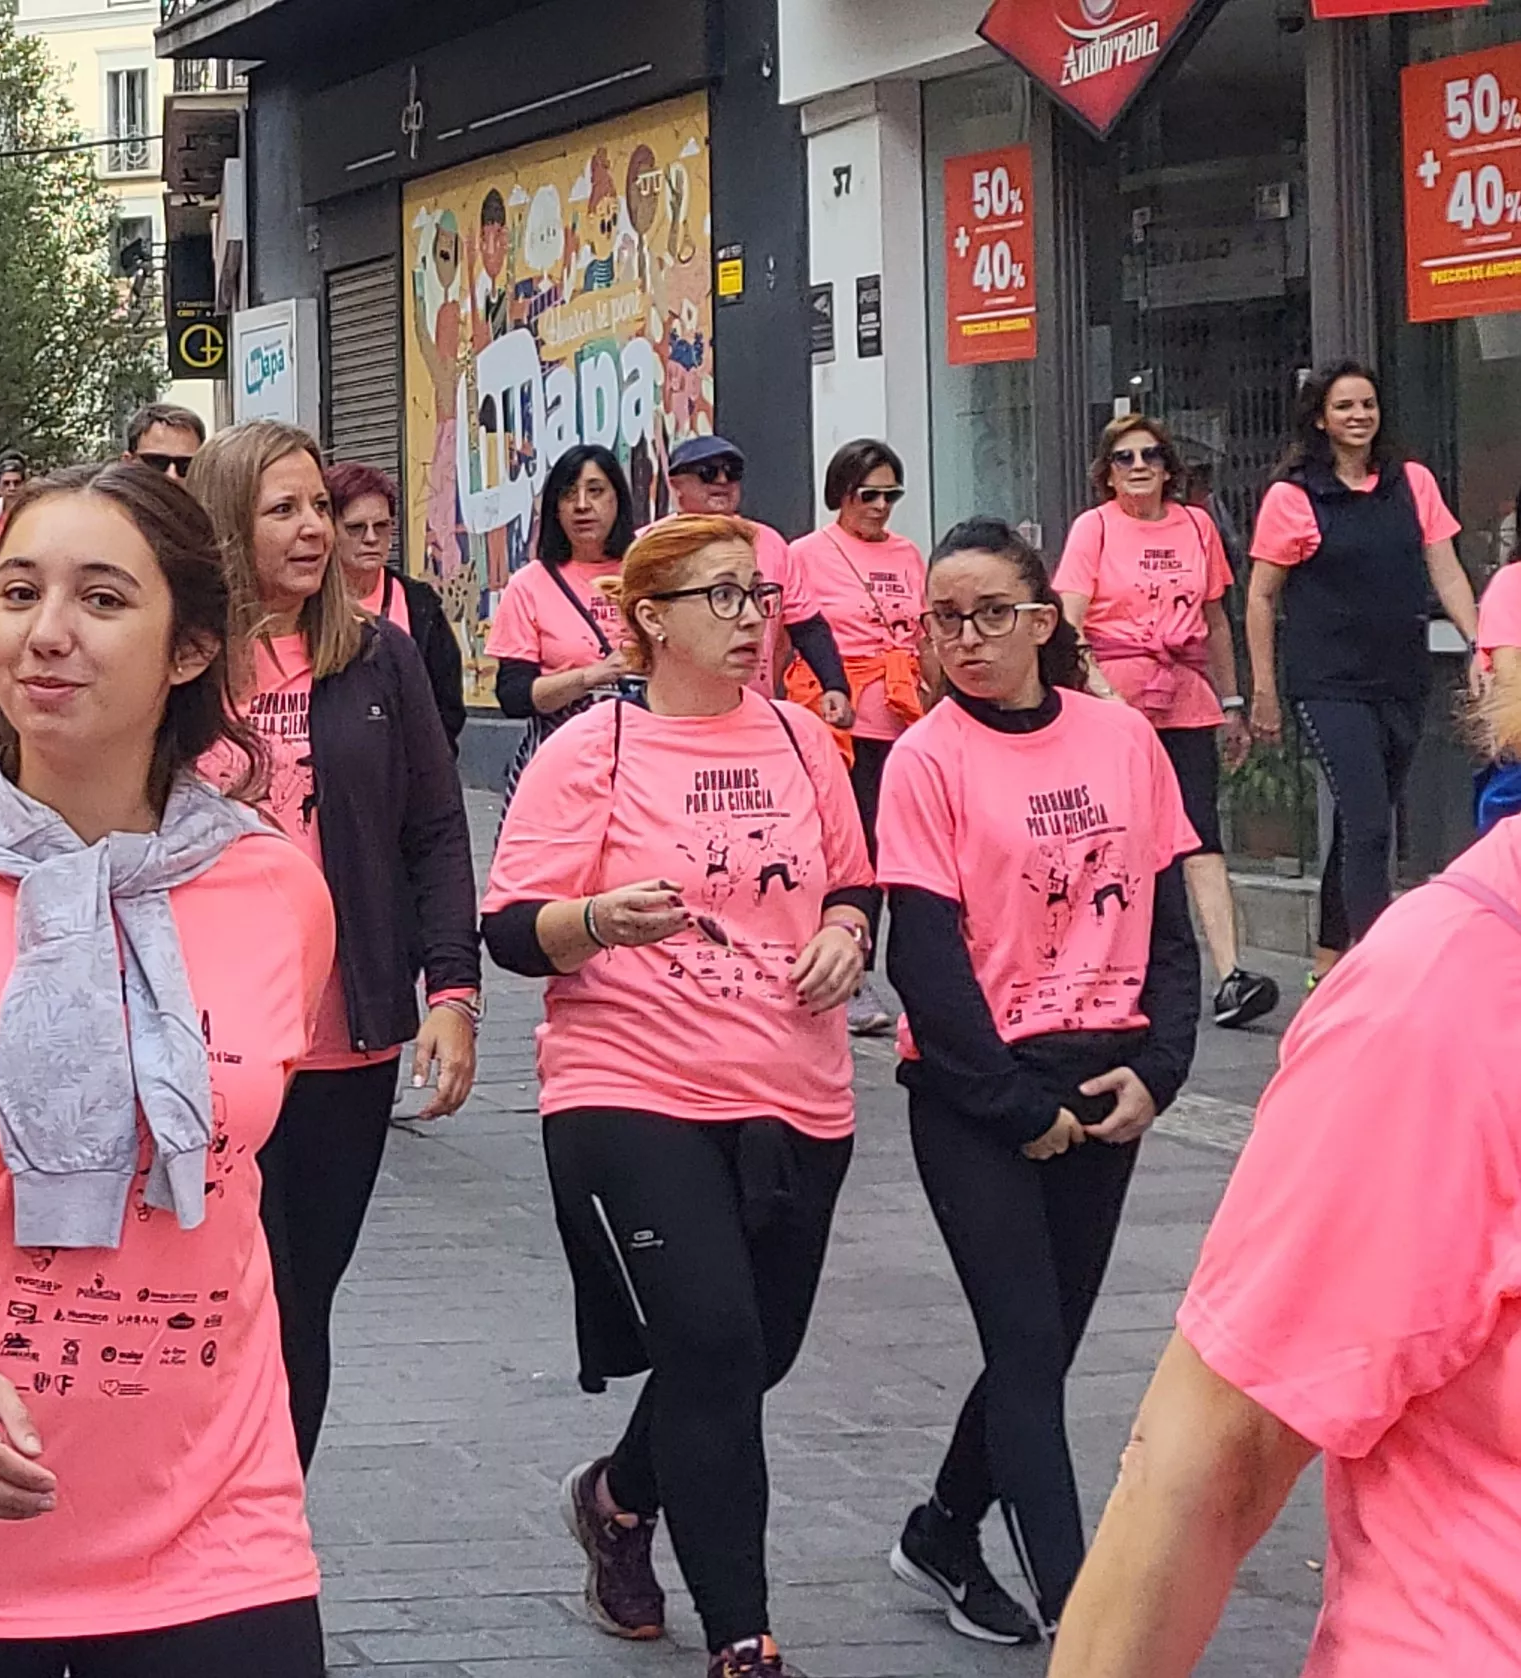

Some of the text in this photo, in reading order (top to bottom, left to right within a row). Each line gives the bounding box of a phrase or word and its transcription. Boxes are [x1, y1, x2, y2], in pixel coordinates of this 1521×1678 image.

[1445, 73, 1521, 140] 50%
[833, 164, 852, 197] 37
[972, 166, 1024, 219] 50%
[1446, 164, 1521, 231] 40%
[973, 240, 1025, 292] 40%
[249, 692, 309, 714] CORRAMO
[280, 714, 309, 735] CIEN
[694, 768, 759, 791] CORRAMOS
[686, 789, 774, 815] POR LA CIENCIA
[117, 1313, 159, 1327] URBAN
